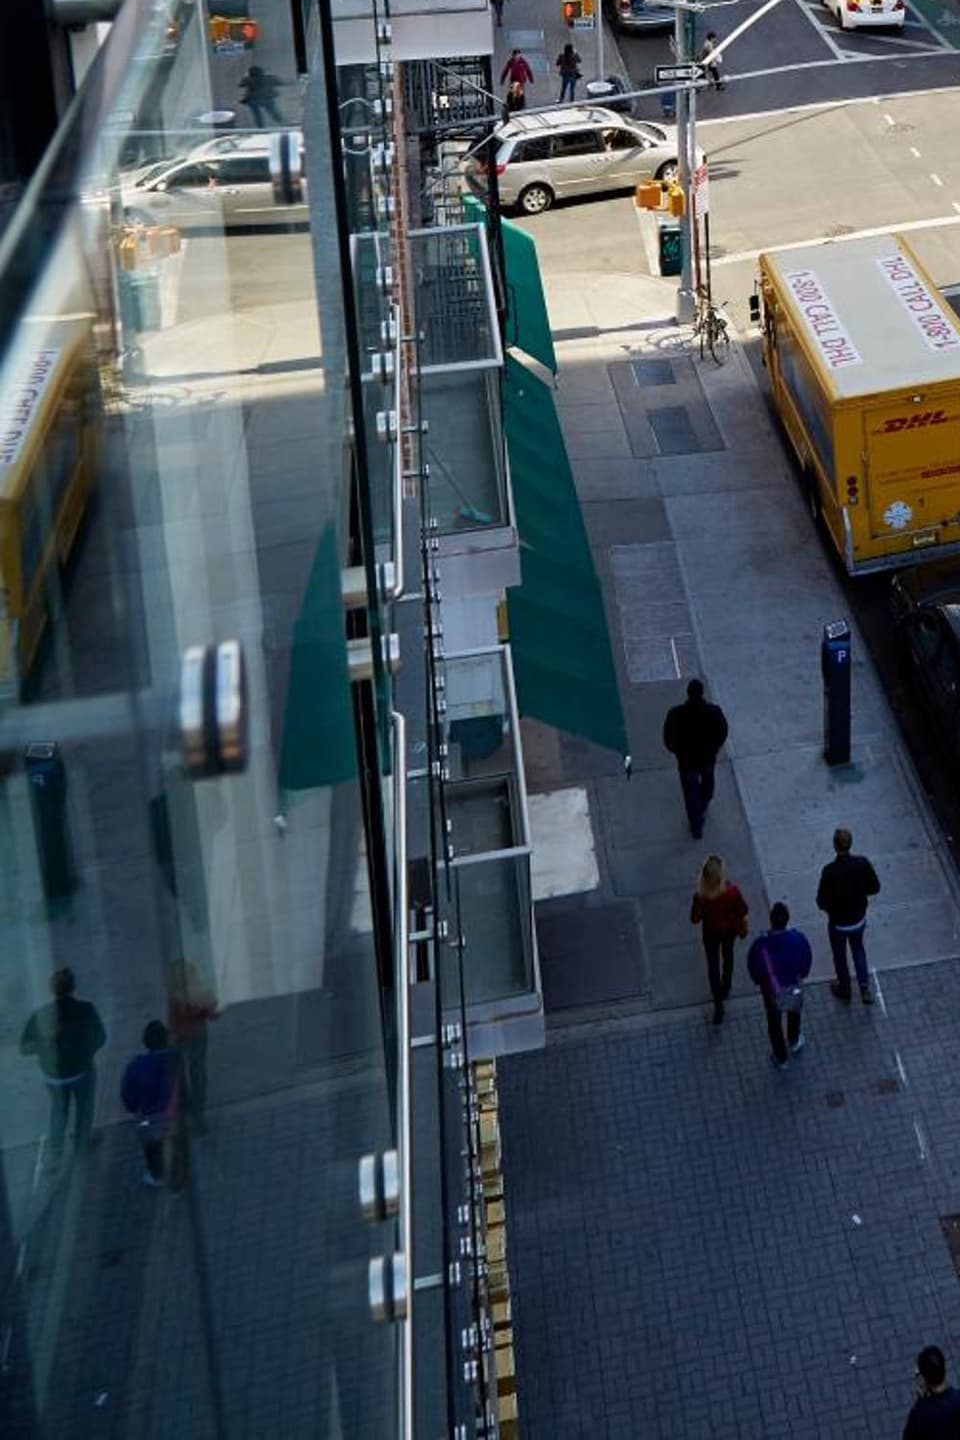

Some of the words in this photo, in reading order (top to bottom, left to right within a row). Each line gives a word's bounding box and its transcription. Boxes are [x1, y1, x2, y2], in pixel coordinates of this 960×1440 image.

[882, 256, 914, 281] DHL
[787, 271, 822, 303] 1-800
[898, 281, 934, 312] CALL
[805, 304, 840, 336] CALL
[821, 337, 857, 368] DHL
[883, 410, 948, 433] DHL
[837, 649, 847, 664] P
